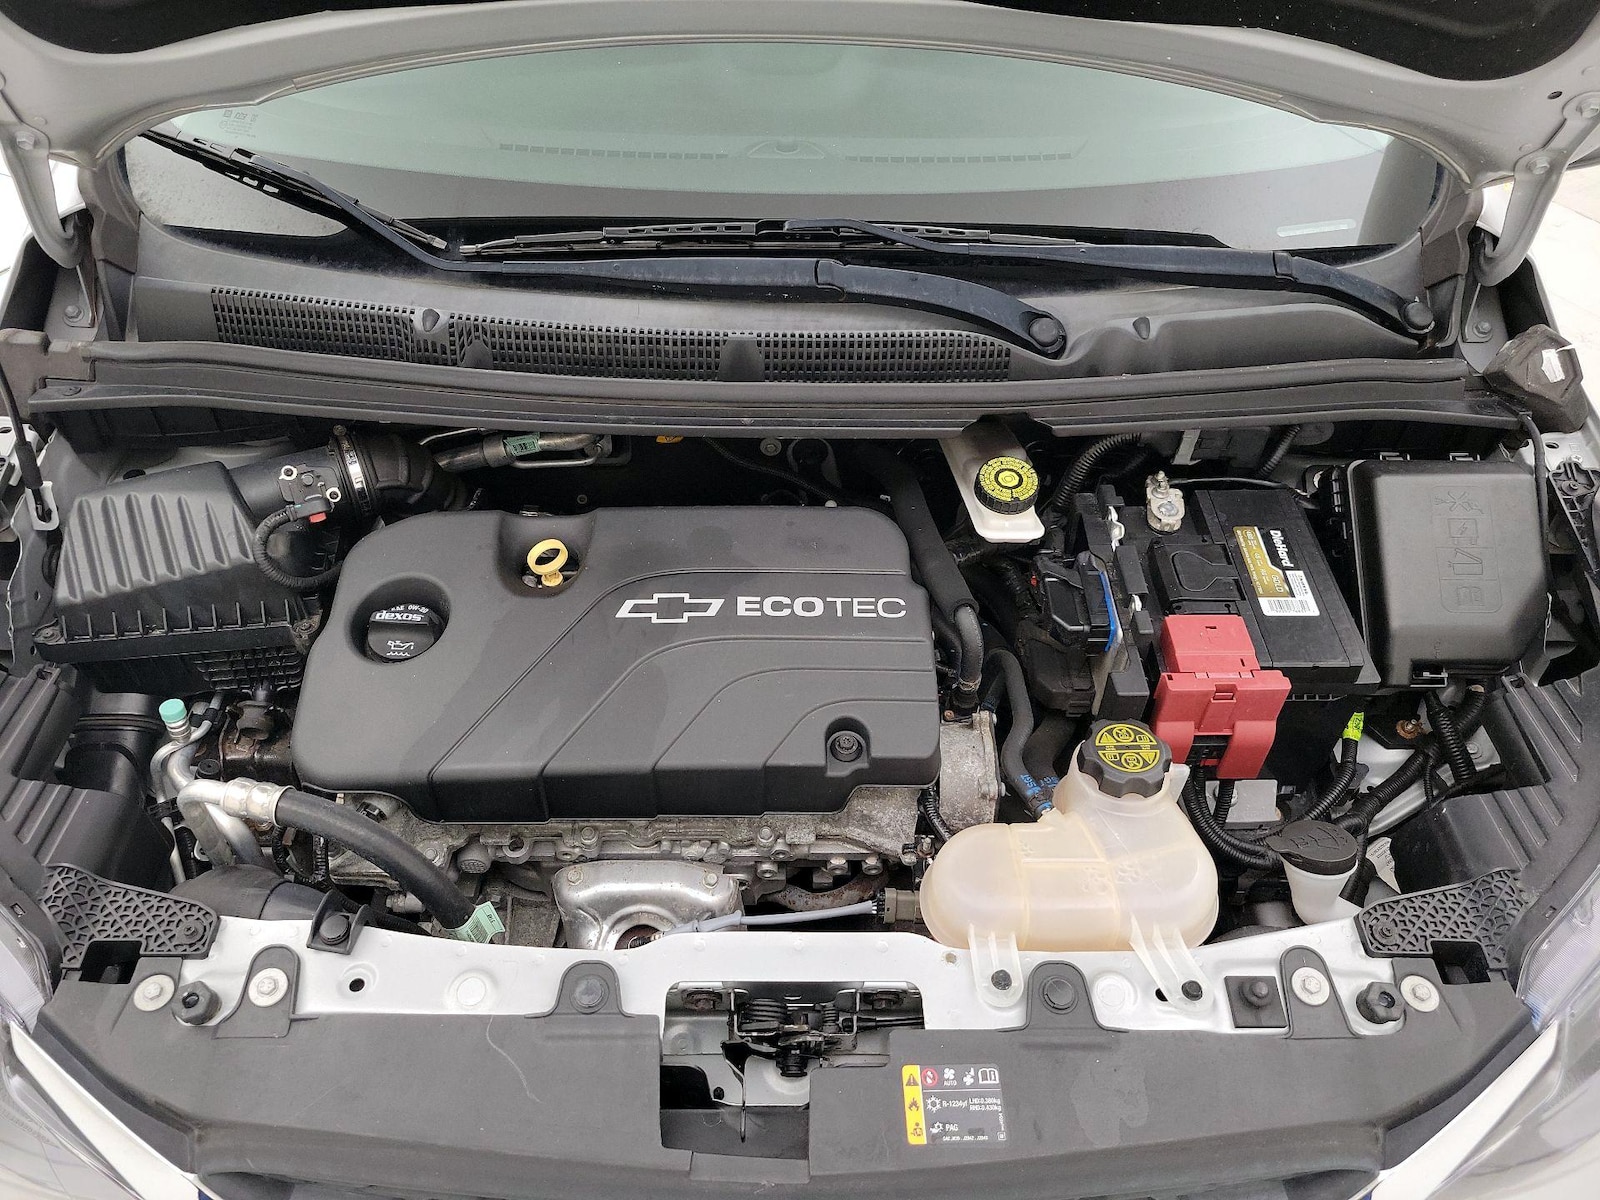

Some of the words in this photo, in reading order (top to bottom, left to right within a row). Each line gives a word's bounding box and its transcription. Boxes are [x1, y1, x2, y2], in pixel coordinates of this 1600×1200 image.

[1270, 530, 1294, 567] DieHard
[1272, 575, 1284, 593] GOLD
[408, 604, 429, 614] 0W-20
[736, 596, 907, 618] ECOTEC
[375, 610, 425, 621] dexos
[942, 1100, 968, 1108] R-1234yf
